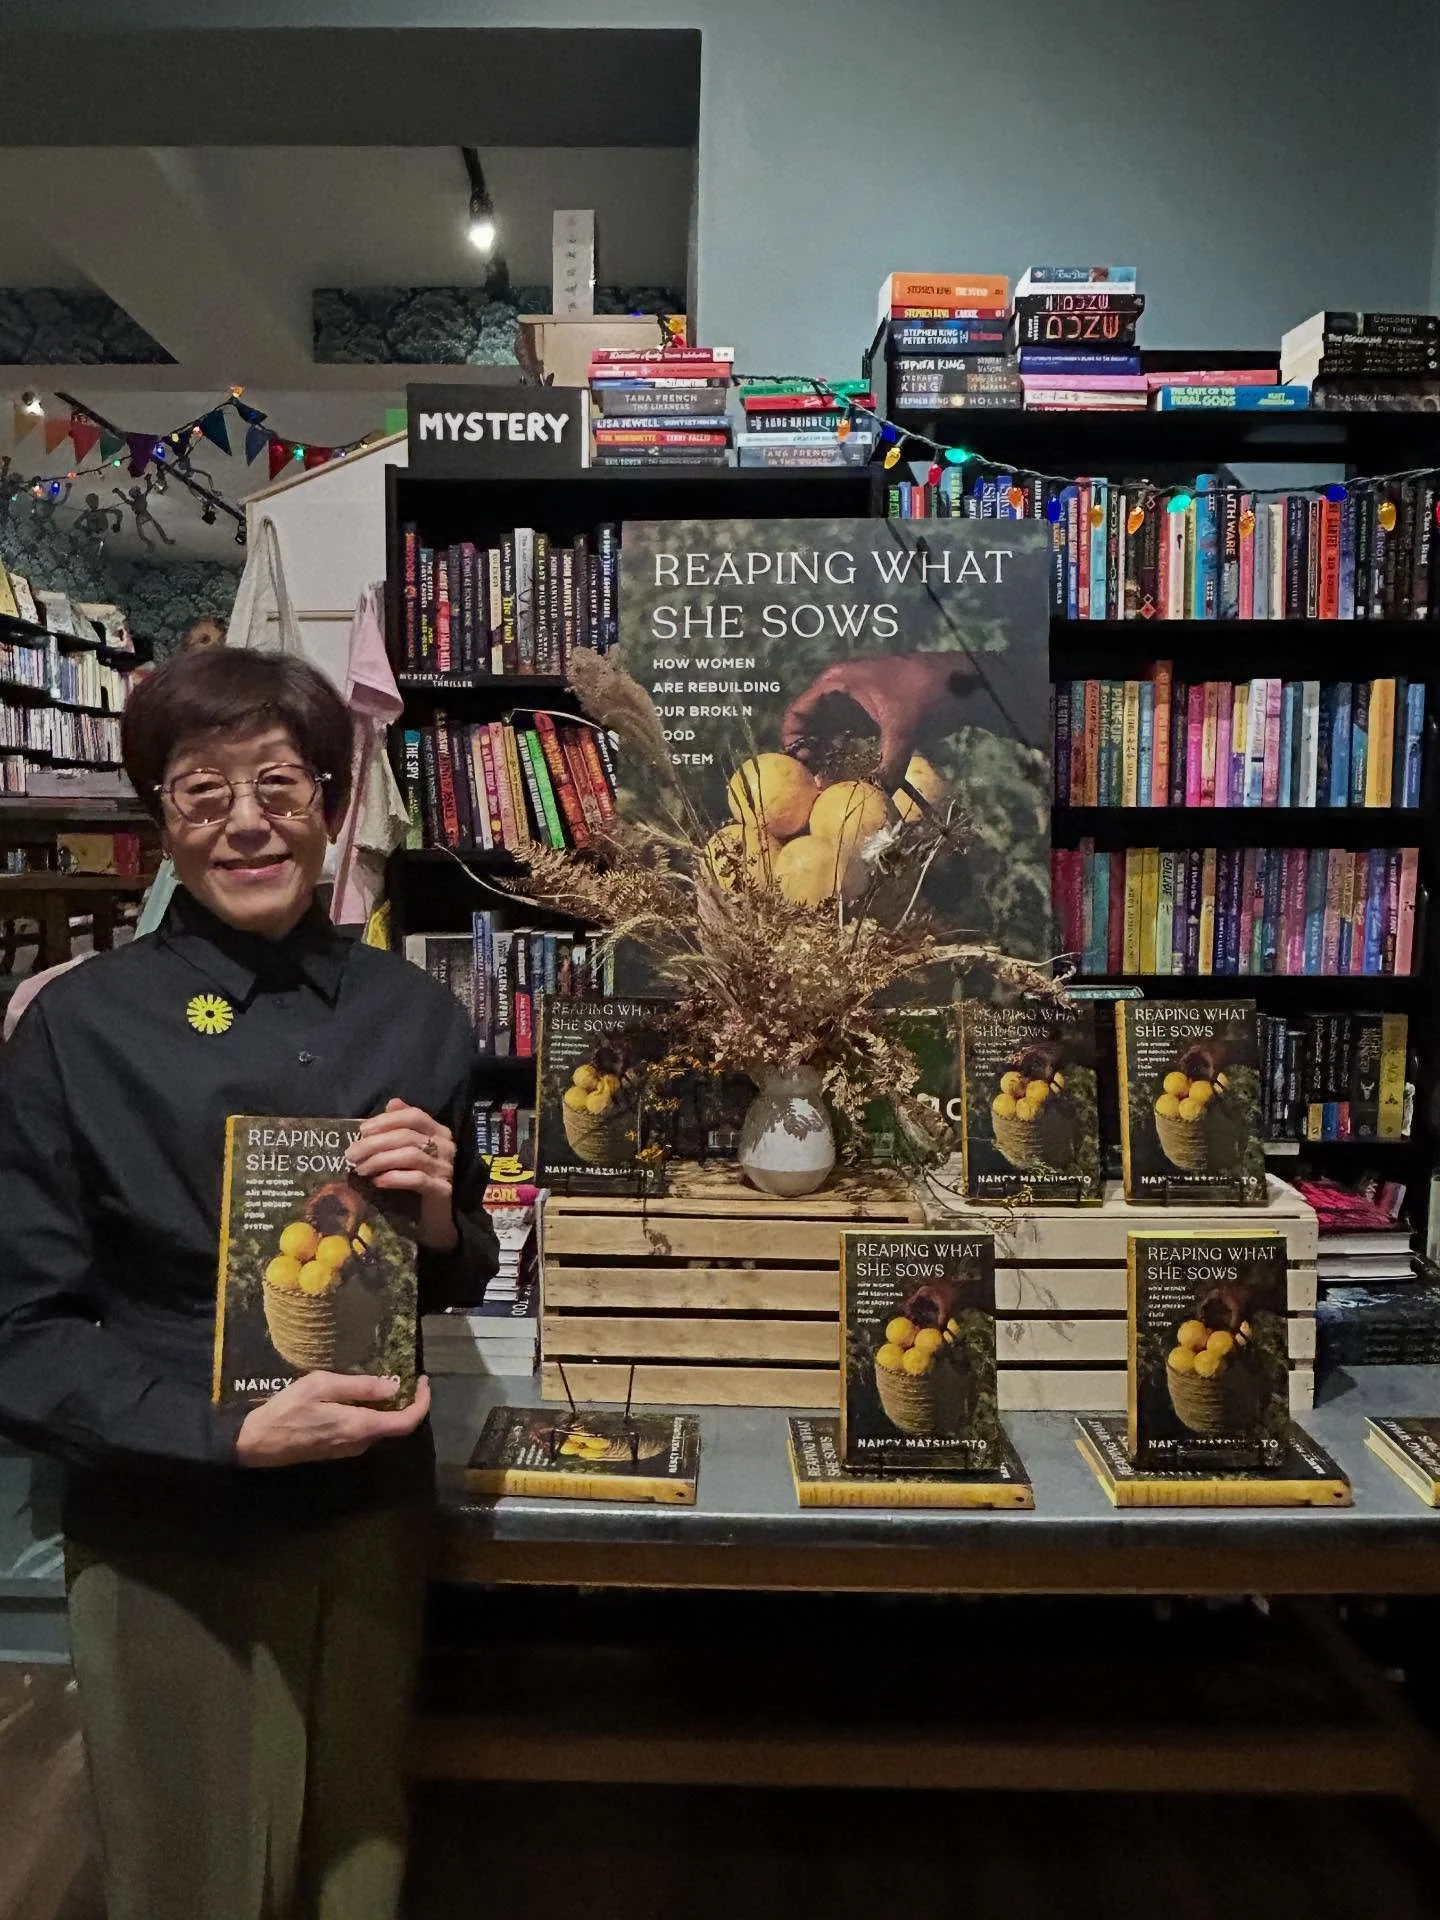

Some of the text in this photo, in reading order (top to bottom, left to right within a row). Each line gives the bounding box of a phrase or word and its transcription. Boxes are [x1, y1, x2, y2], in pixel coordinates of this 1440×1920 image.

[903, 328, 958, 337] STEPHEN KING
[902, 336, 926, 345] PETER
[927, 336, 959, 345] STRAUB
[937, 359, 966, 370] KING
[901, 382, 939, 392] KING
[655, 394, 698, 402] FRENCH
[419, 412, 569, 444] MYSTERY
[597, 418, 660, 428] LISA JEWELL
[1423, 511, 1432, 532] Chan
[1226, 521, 1236, 555] WARE
[654, 550, 1013, 587] REAPING WHAT
[564, 554, 572, 617] JOHN BANVILLE
[651, 603, 899, 640] SHE SOWS
[653, 657, 756, 670] HOW WOMEN
[432, 680, 473, 688] THRILLER
[652, 681, 781, 694] ARE REBUILDING
[655, 705, 685, 717] OUR
[662, 729, 695, 742] OOD
[405, 741, 419, 779] THE SPY
[668, 753, 714, 766] STEM
[1134, 1008, 1249, 1021] REAPING WHAT
[1135, 1025, 1215, 1038] SHE SOWS
[248, 1129, 341, 1148] REAPING
[246, 1153, 292, 1172] SHE
[978, 1175, 1017, 1183] NANCY
[1141, 1175, 1181, 1184] NAN
[856, 1243, 983, 1258] REAPING WHAT
[1148, 1246, 1277, 1261] REAPING WHAT
[856, 1263, 945, 1278] SHE SOWS
[1147, 1266, 1238, 1281] SHE SOWS
[234, 1377, 293, 1392] NANCY
[857, 1439, 902, 1448] NANCY
